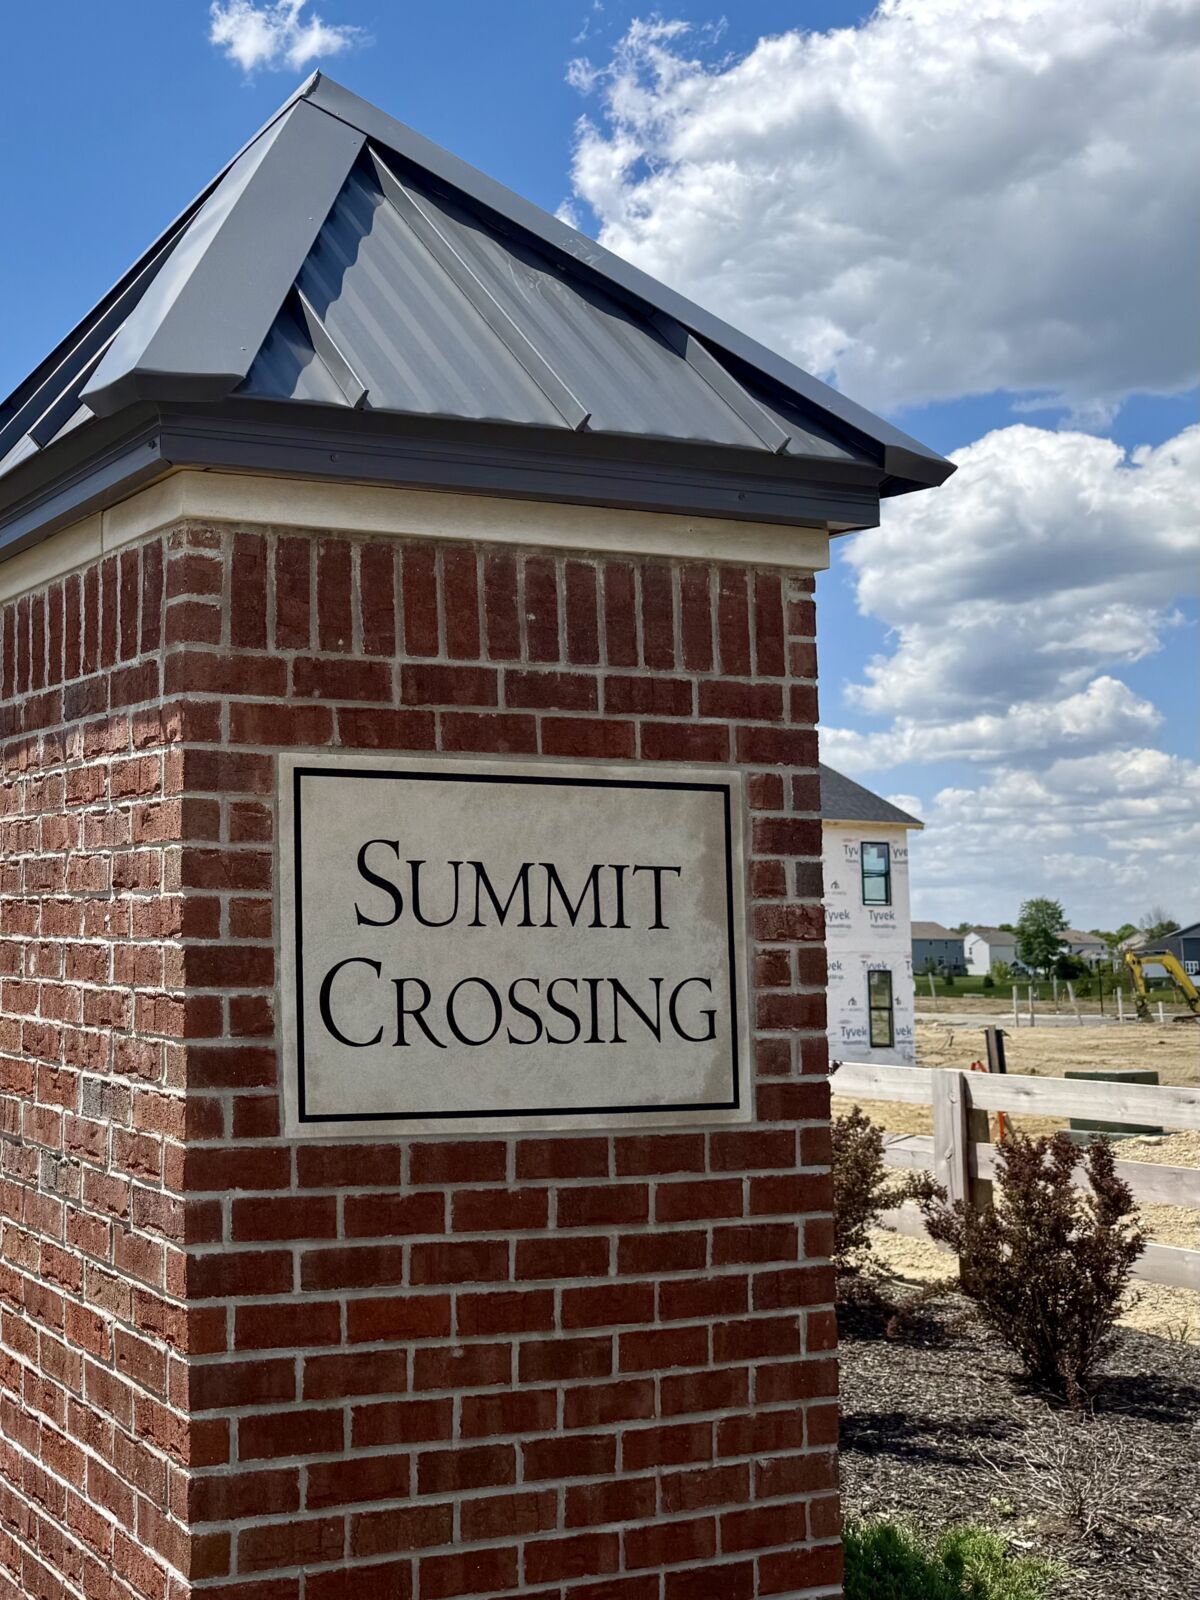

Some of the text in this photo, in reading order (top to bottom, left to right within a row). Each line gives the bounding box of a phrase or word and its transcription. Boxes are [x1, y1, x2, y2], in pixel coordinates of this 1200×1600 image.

[843, 844, 858, 857] Tyv
[354, 839, 682, 930] SUMMIT
[868, 909, 895, 923] Tyvek
[319, 957, 717, 1049] CROSSING
[841, 1026, 867, 1039] Tyvek
[896, 1025, 912, 1036] vek
